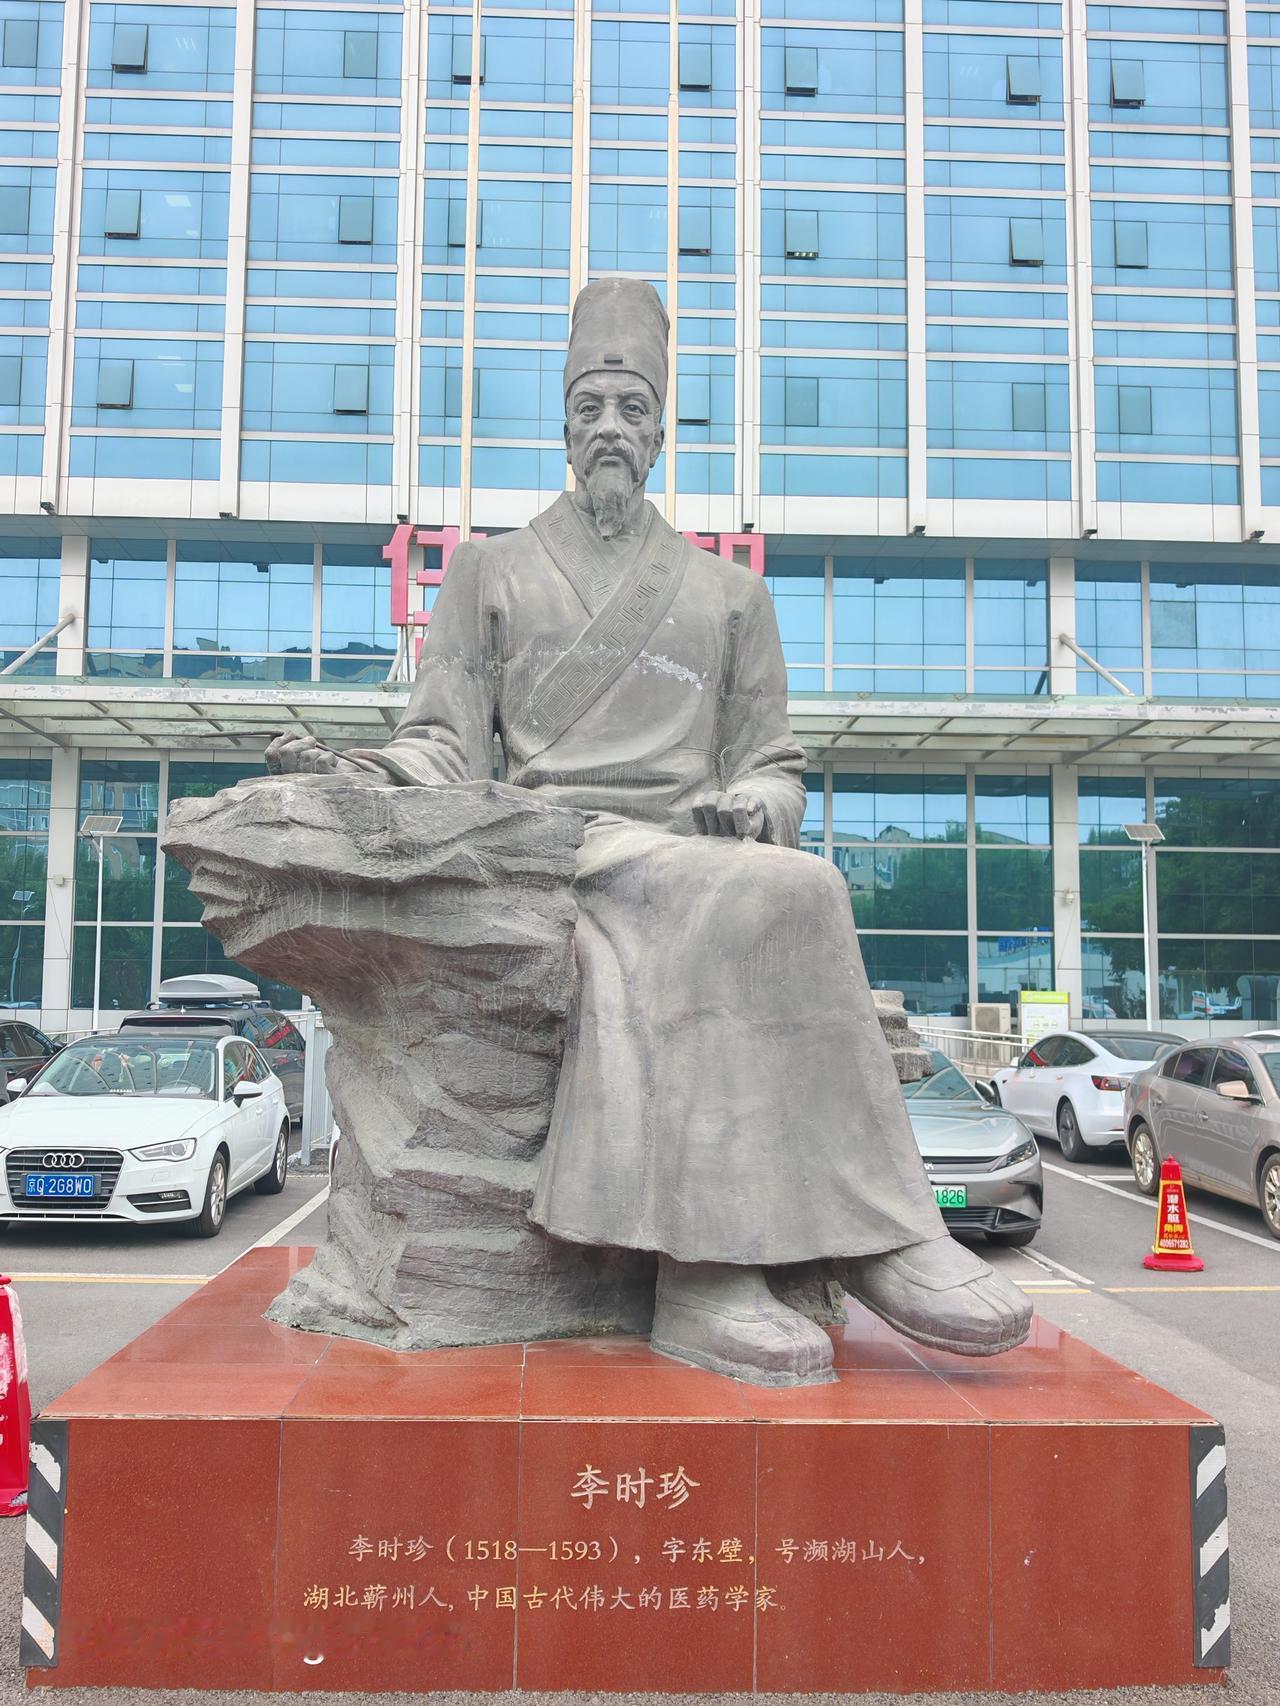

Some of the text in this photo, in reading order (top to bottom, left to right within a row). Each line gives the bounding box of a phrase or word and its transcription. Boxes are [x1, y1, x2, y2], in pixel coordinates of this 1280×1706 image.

[935, 1189, 965, 1205] 1826
[570, 1463, 701, 1510] 李时珍
